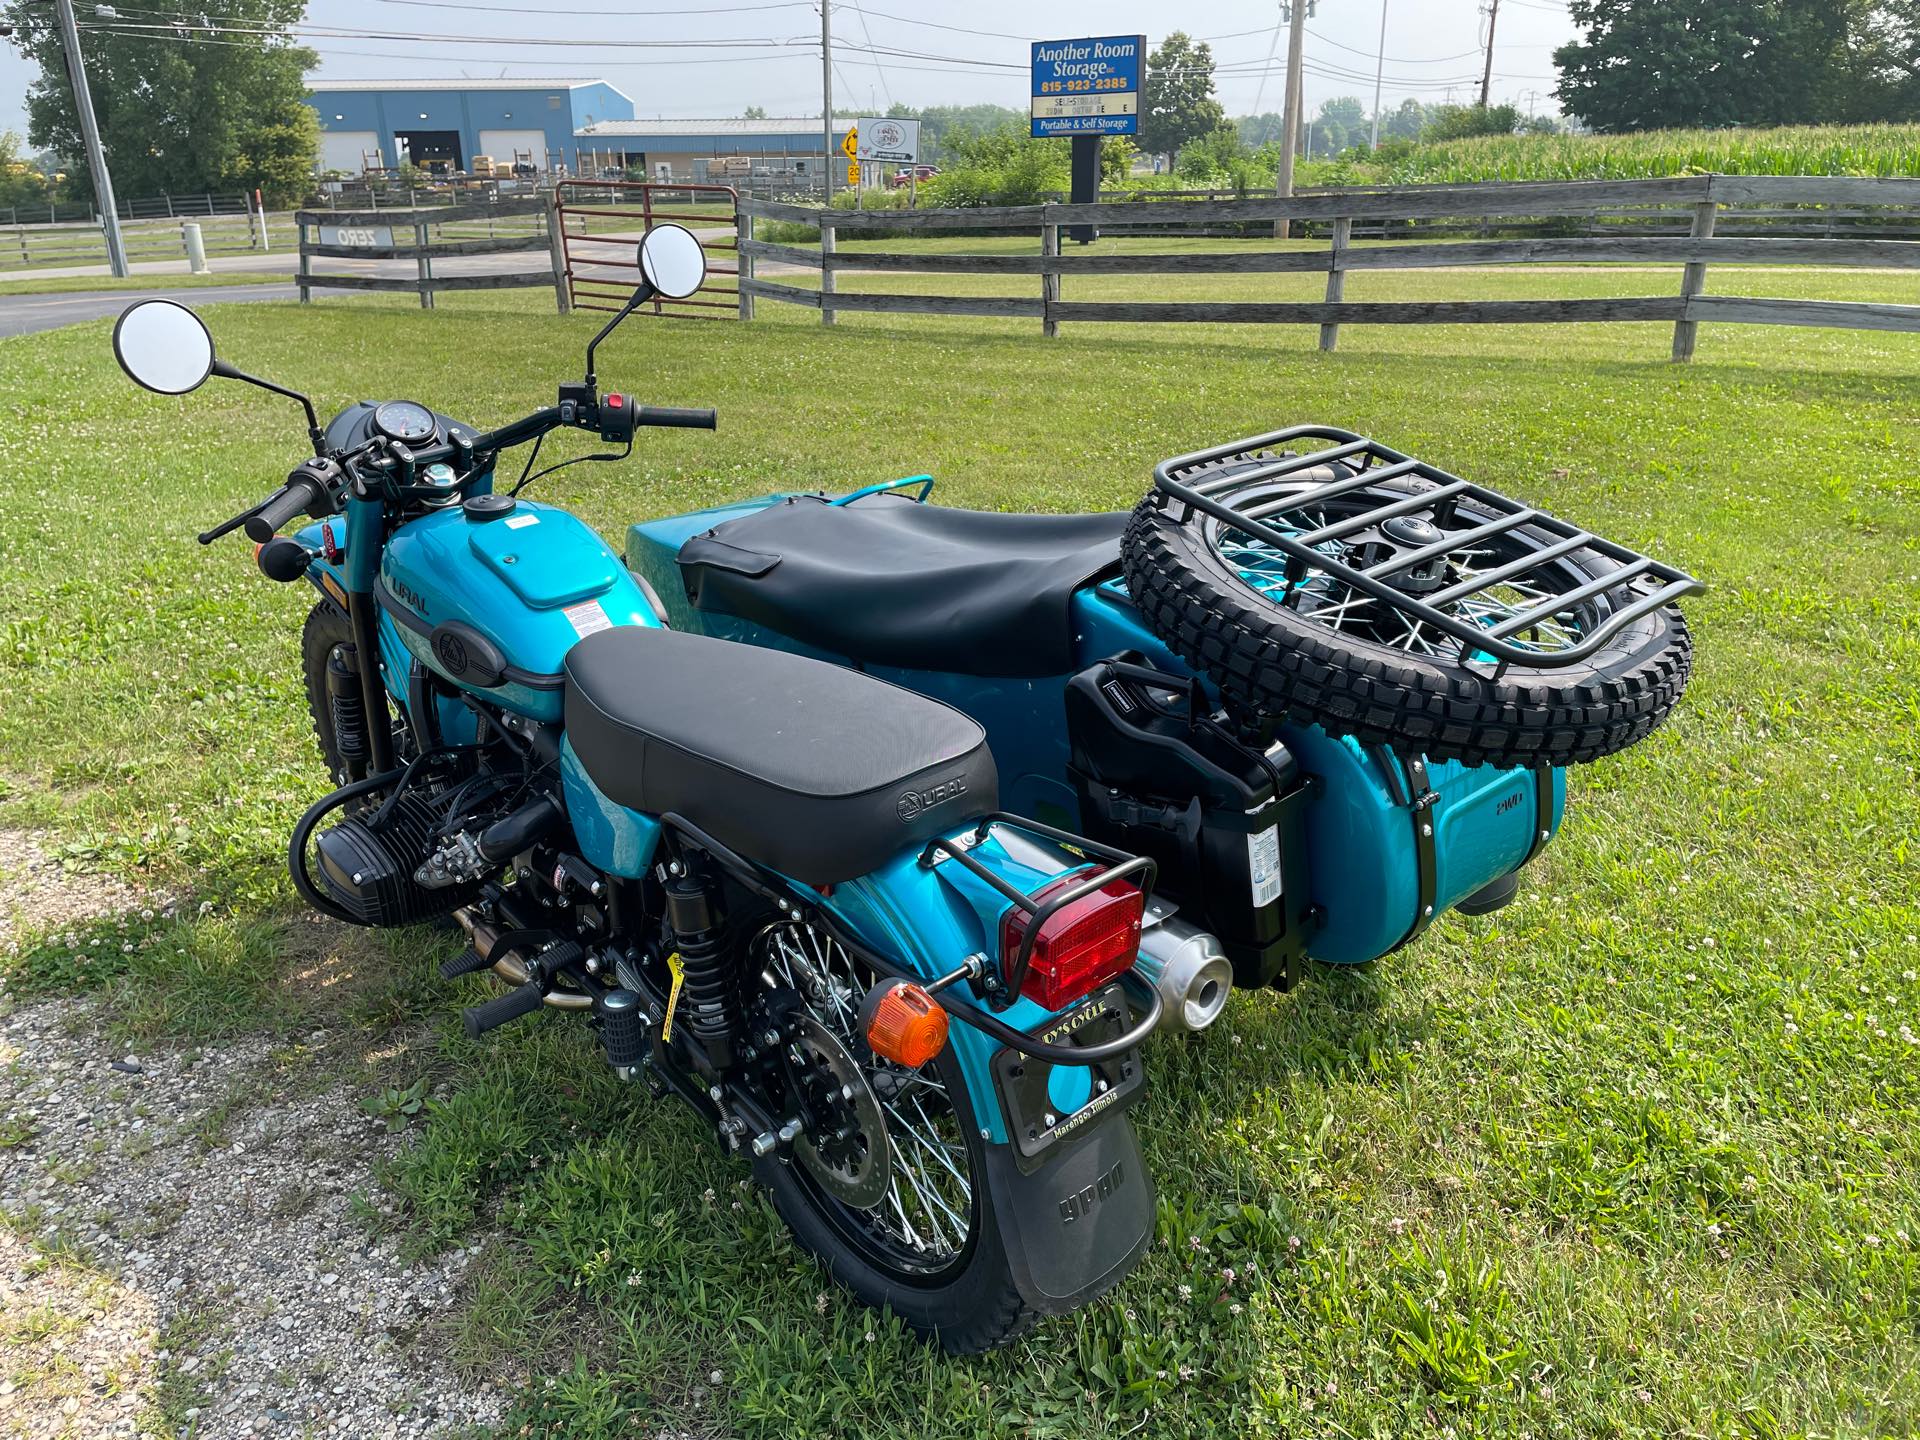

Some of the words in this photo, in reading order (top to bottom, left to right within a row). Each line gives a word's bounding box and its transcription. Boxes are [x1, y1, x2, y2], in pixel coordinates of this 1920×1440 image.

[1036, 43, 1091, 62] Another
[1093, 42, 1135, 59] Room
[1053, 61, 1107, 80] Storage
[1041, 77, 1127, 92] 815-923-2385
[1040, 119, 1072, 130] Portable
[1073, 119, 1080, 129] &
[1081, 118, 1096, 129] Self
[1097, 117, 1128, 131] Storage
[849, 167, 860, 176] 20
[392, 577, 430, 616] URAL
[922, 778, 967, 806] URAL
[1071, 1000, 1107, 1029] CYCLE
[1054, 1111, 1091, 1139] Marengo,
[1091, 1090, 1118, 1114] Illinois
